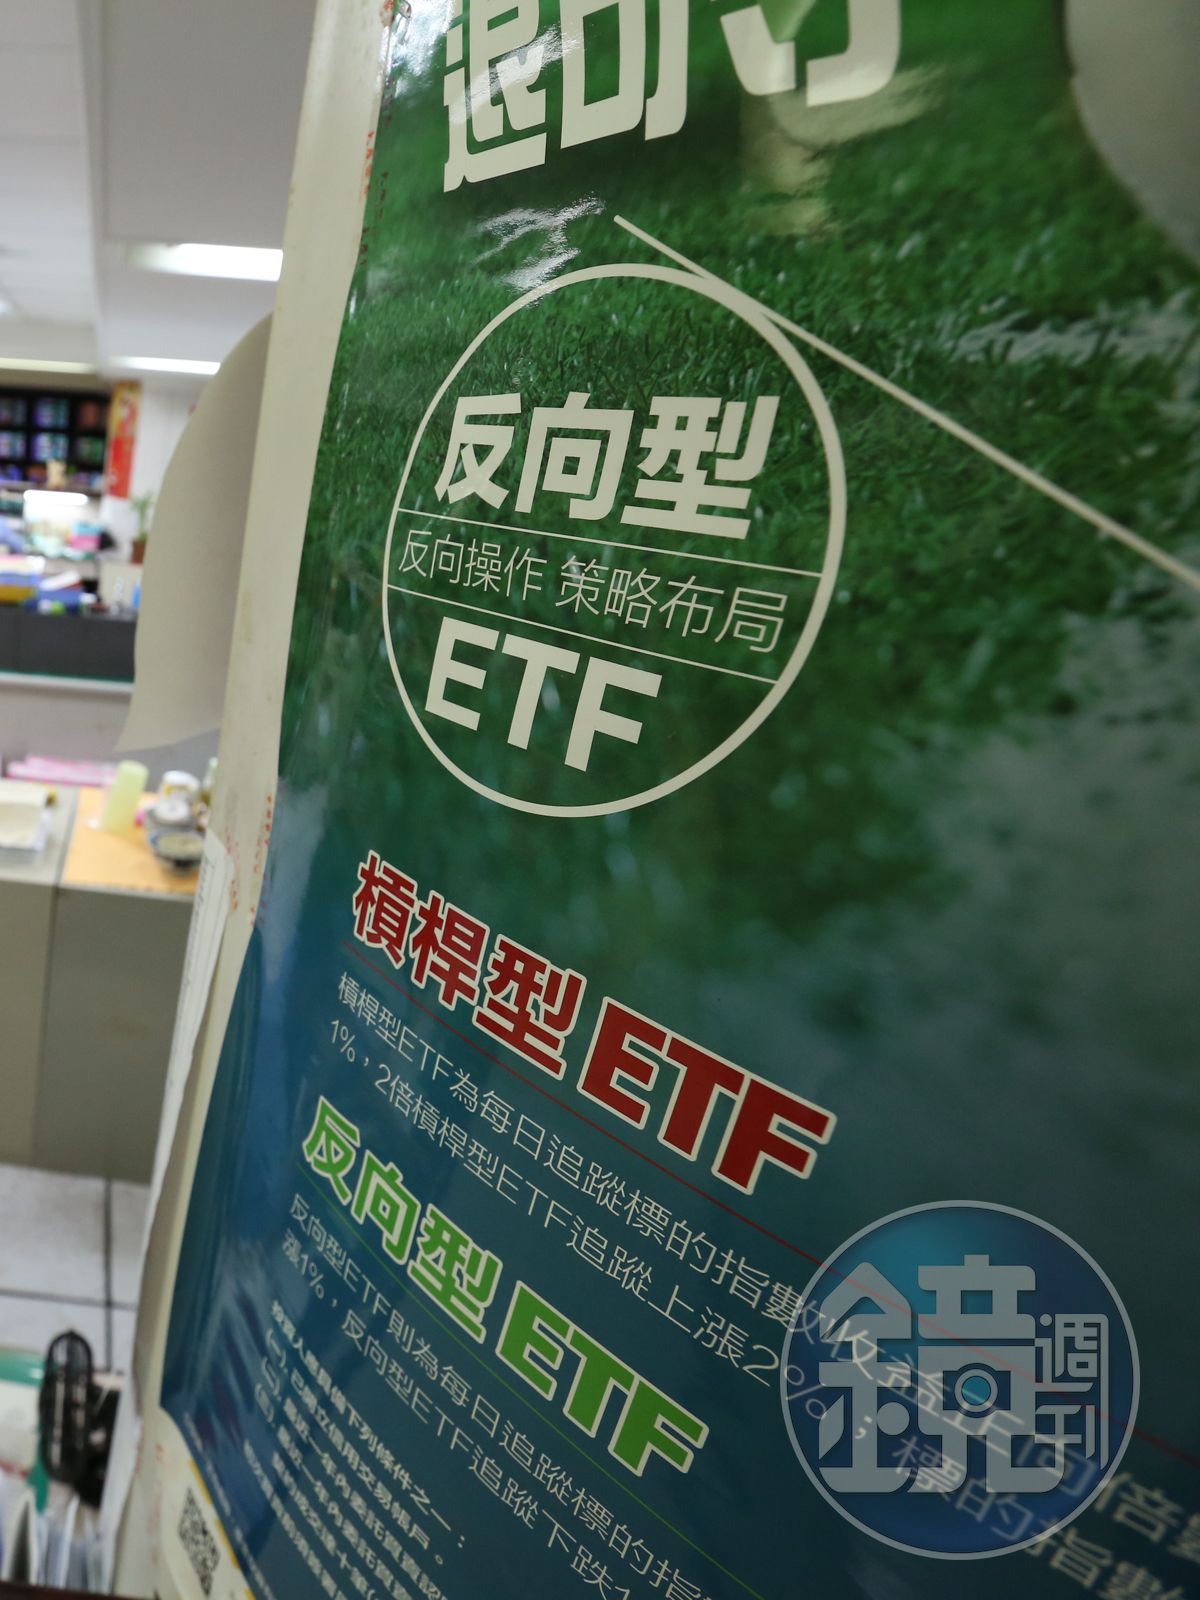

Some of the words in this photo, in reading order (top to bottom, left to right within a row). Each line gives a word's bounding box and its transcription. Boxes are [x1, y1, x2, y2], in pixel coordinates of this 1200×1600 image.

[434, 392, 780, 540] 反向型
[398, 528, 548, 600] 反向操作
[555, 556, 789, 653] 策略布局
[424, 616, 663, 773] ETF
[352, 849, 587, 1081] 槓桿型
[576, 996, 837, 1195] ETF
[302, 1095, 504, 1344] 反向型
[495, 1280, 710, 1477] ETF
